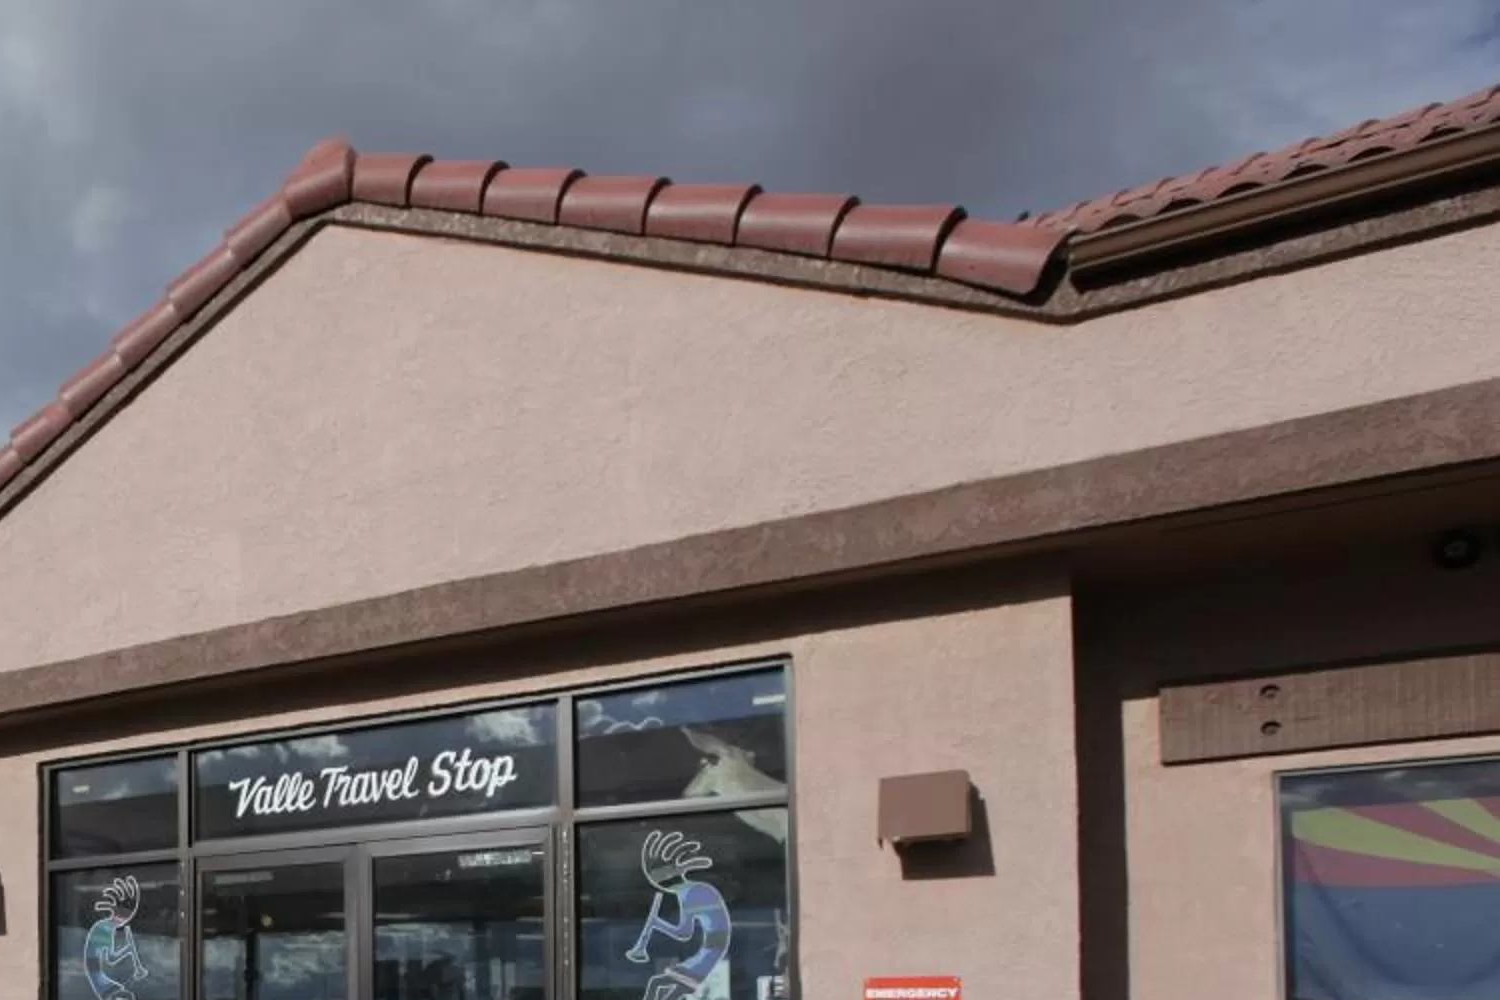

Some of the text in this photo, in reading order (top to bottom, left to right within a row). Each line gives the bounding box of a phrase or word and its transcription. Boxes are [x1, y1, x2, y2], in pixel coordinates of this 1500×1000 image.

[228, 748, 518, 818] Valle Travel Stop
